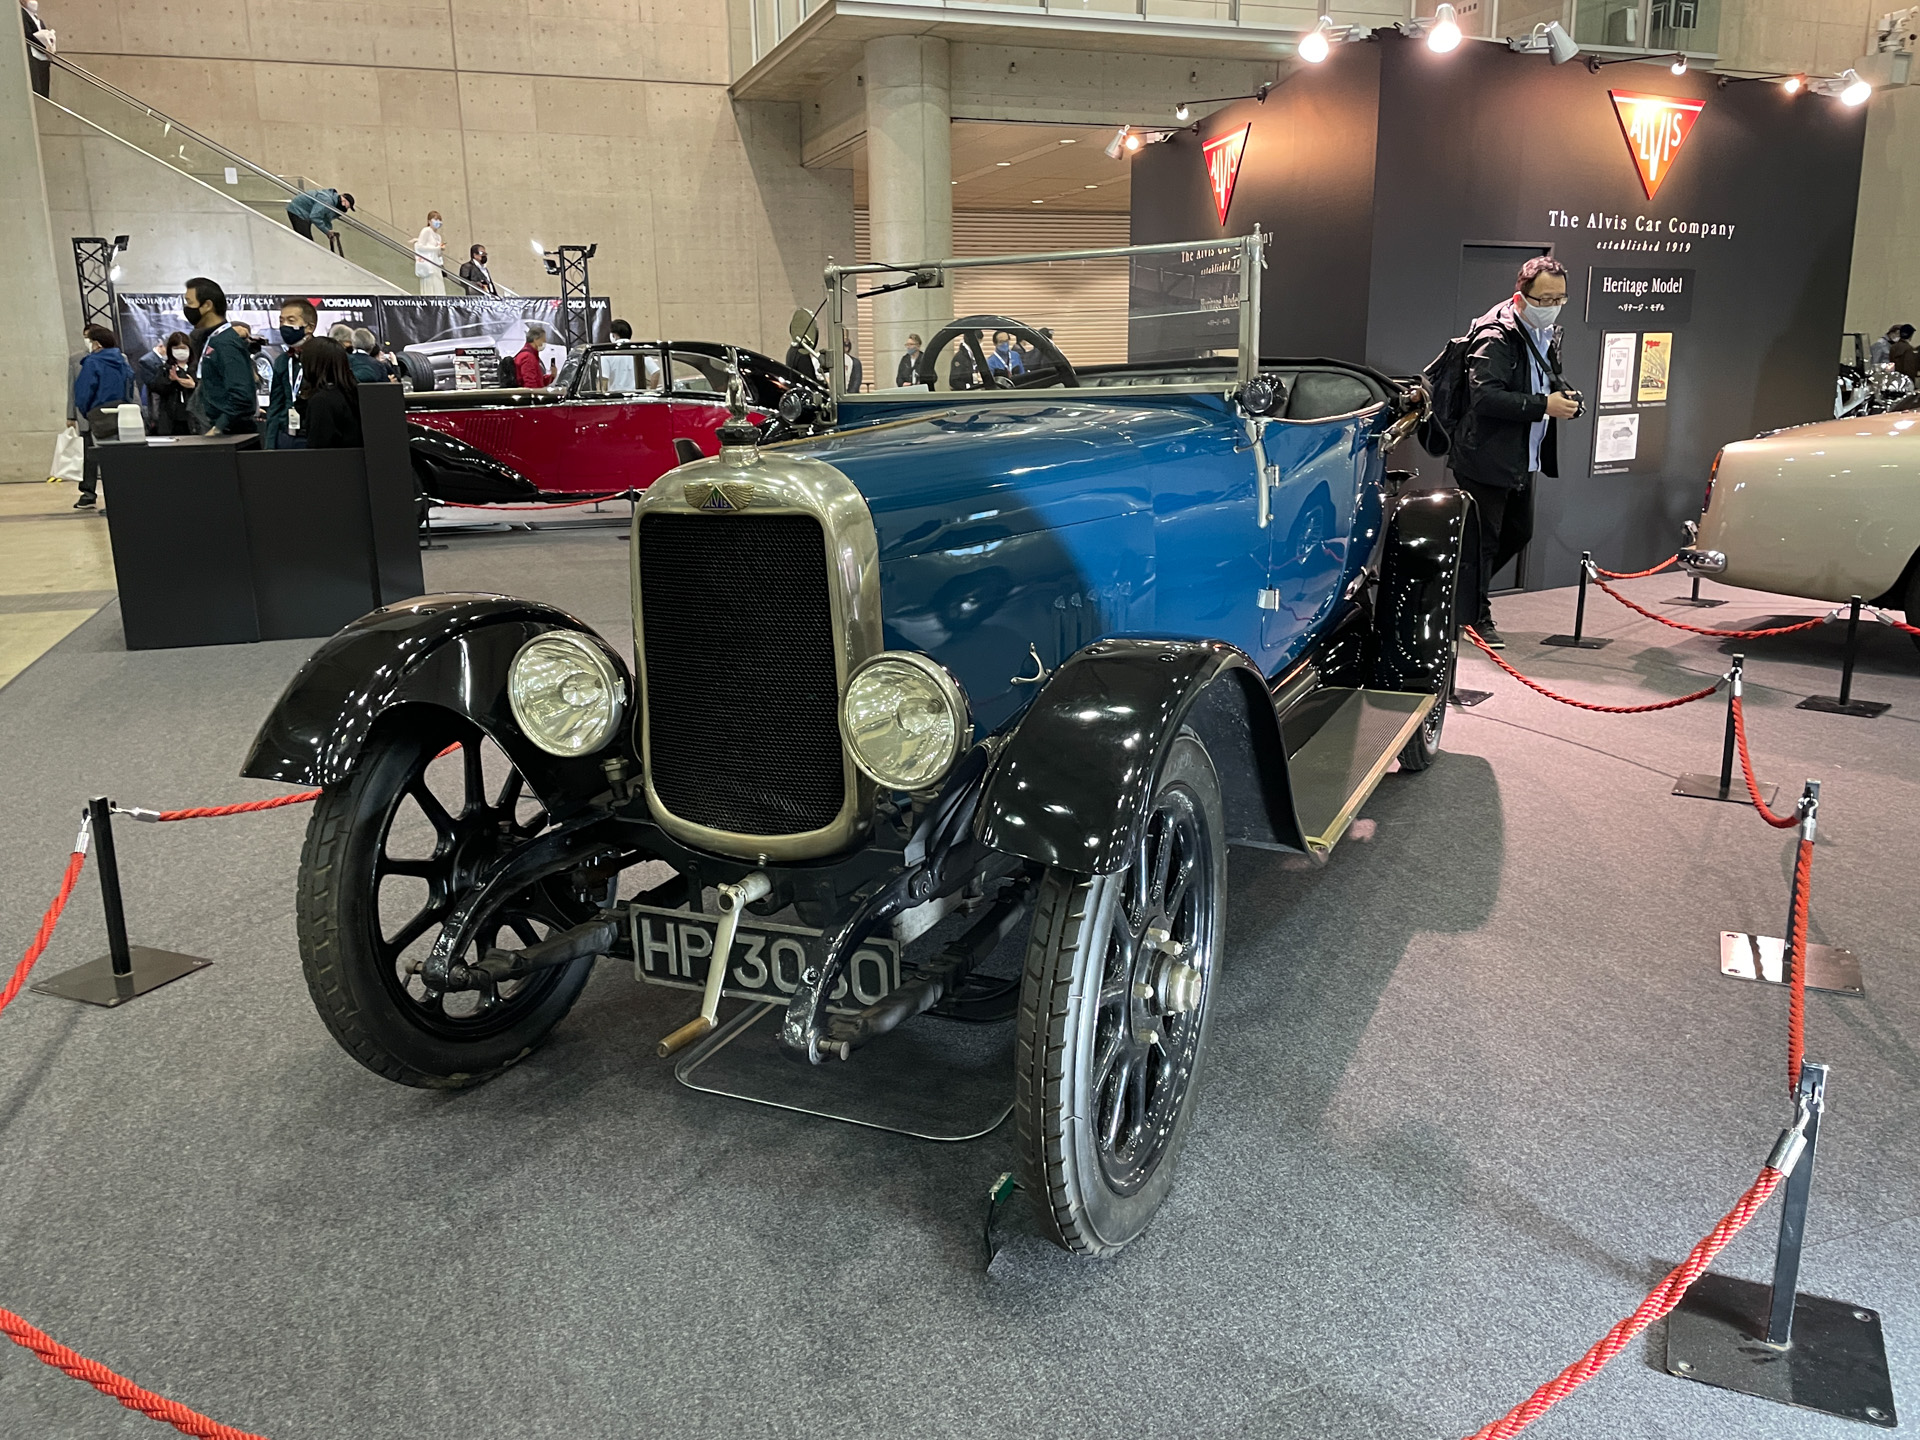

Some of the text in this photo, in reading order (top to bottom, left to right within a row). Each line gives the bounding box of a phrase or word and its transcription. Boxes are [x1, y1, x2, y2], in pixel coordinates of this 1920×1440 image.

[1630, 109, 1682, 181] ALVIS
[1211, 143, 1237, 209] ALVIS
[1548, 210, 1735, 240] The Alvis Car Company
[1596, 239, 1691, 253] established 1919
[1602, 277, 1683, 297] Heritage Model
[321, 298, 373, 308] YOKOHAMA
[704, 492, 730, 508] ALVIS
[641, 917, 713, 978] HP
